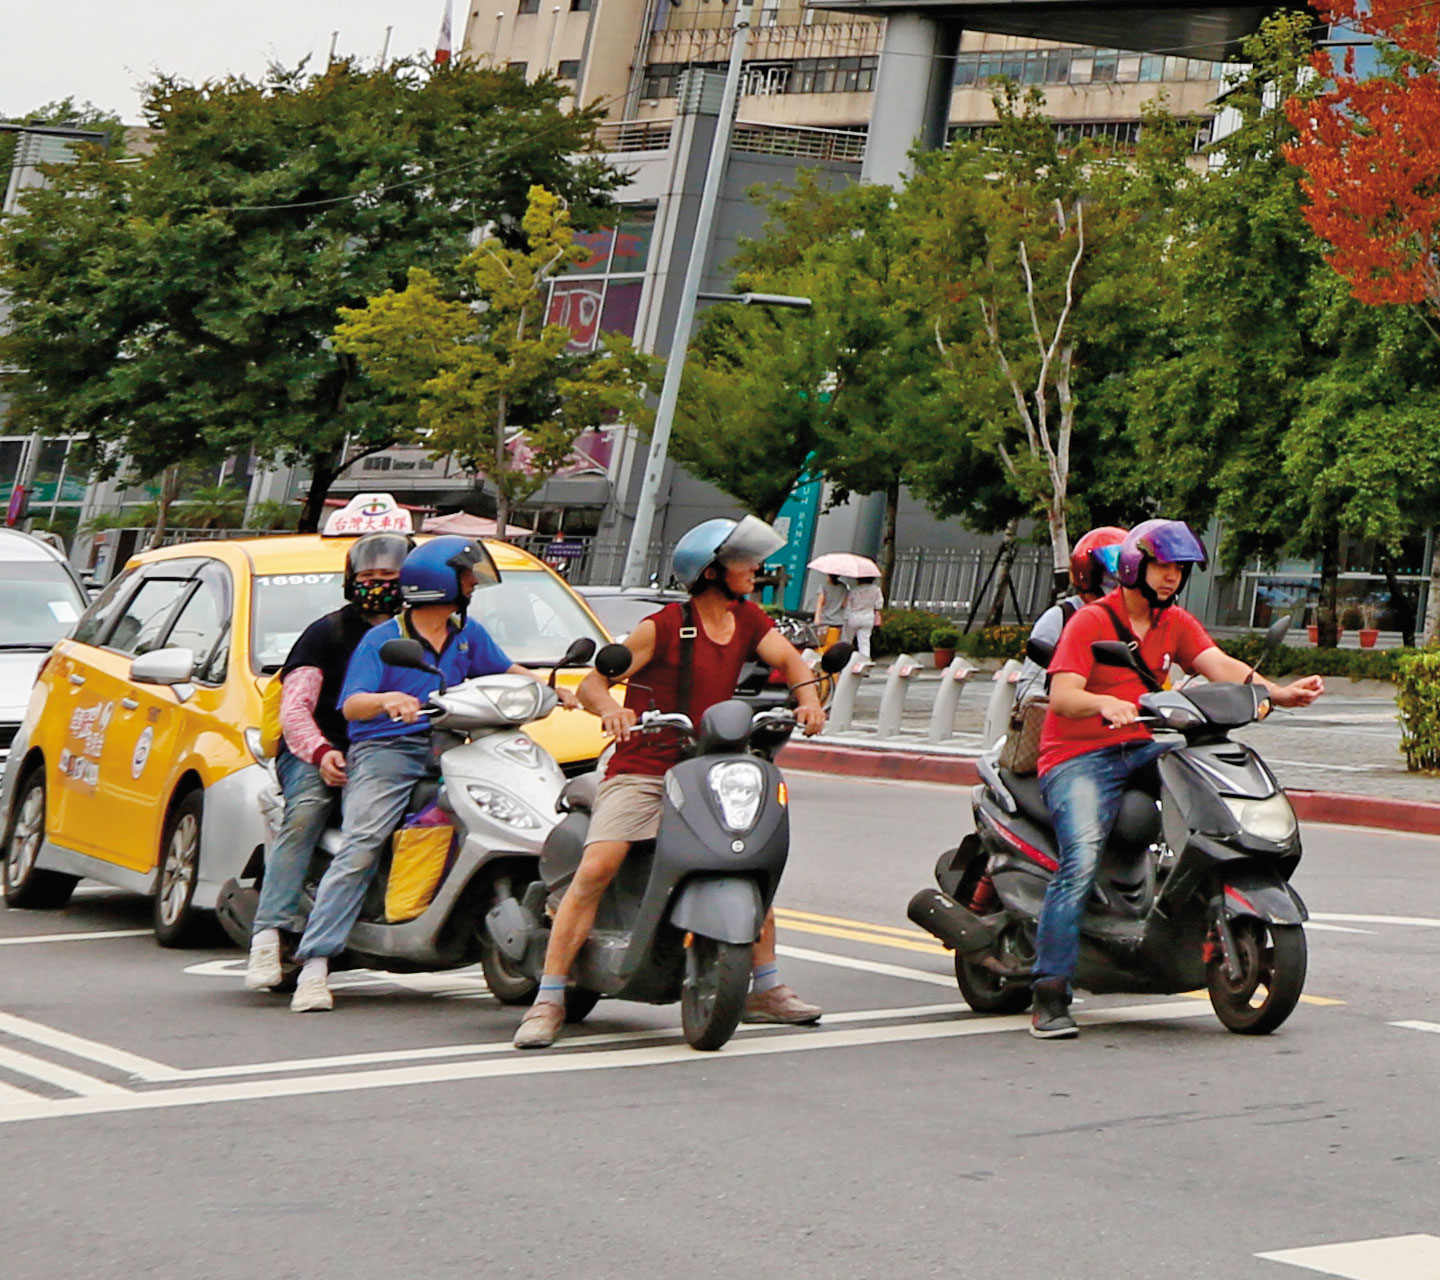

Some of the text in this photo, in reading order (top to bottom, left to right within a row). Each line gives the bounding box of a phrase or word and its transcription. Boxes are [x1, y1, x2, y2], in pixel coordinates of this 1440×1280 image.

[335, 516, 408, 531] 台灣大車隊
[257, 574, 335, 586] 16907
